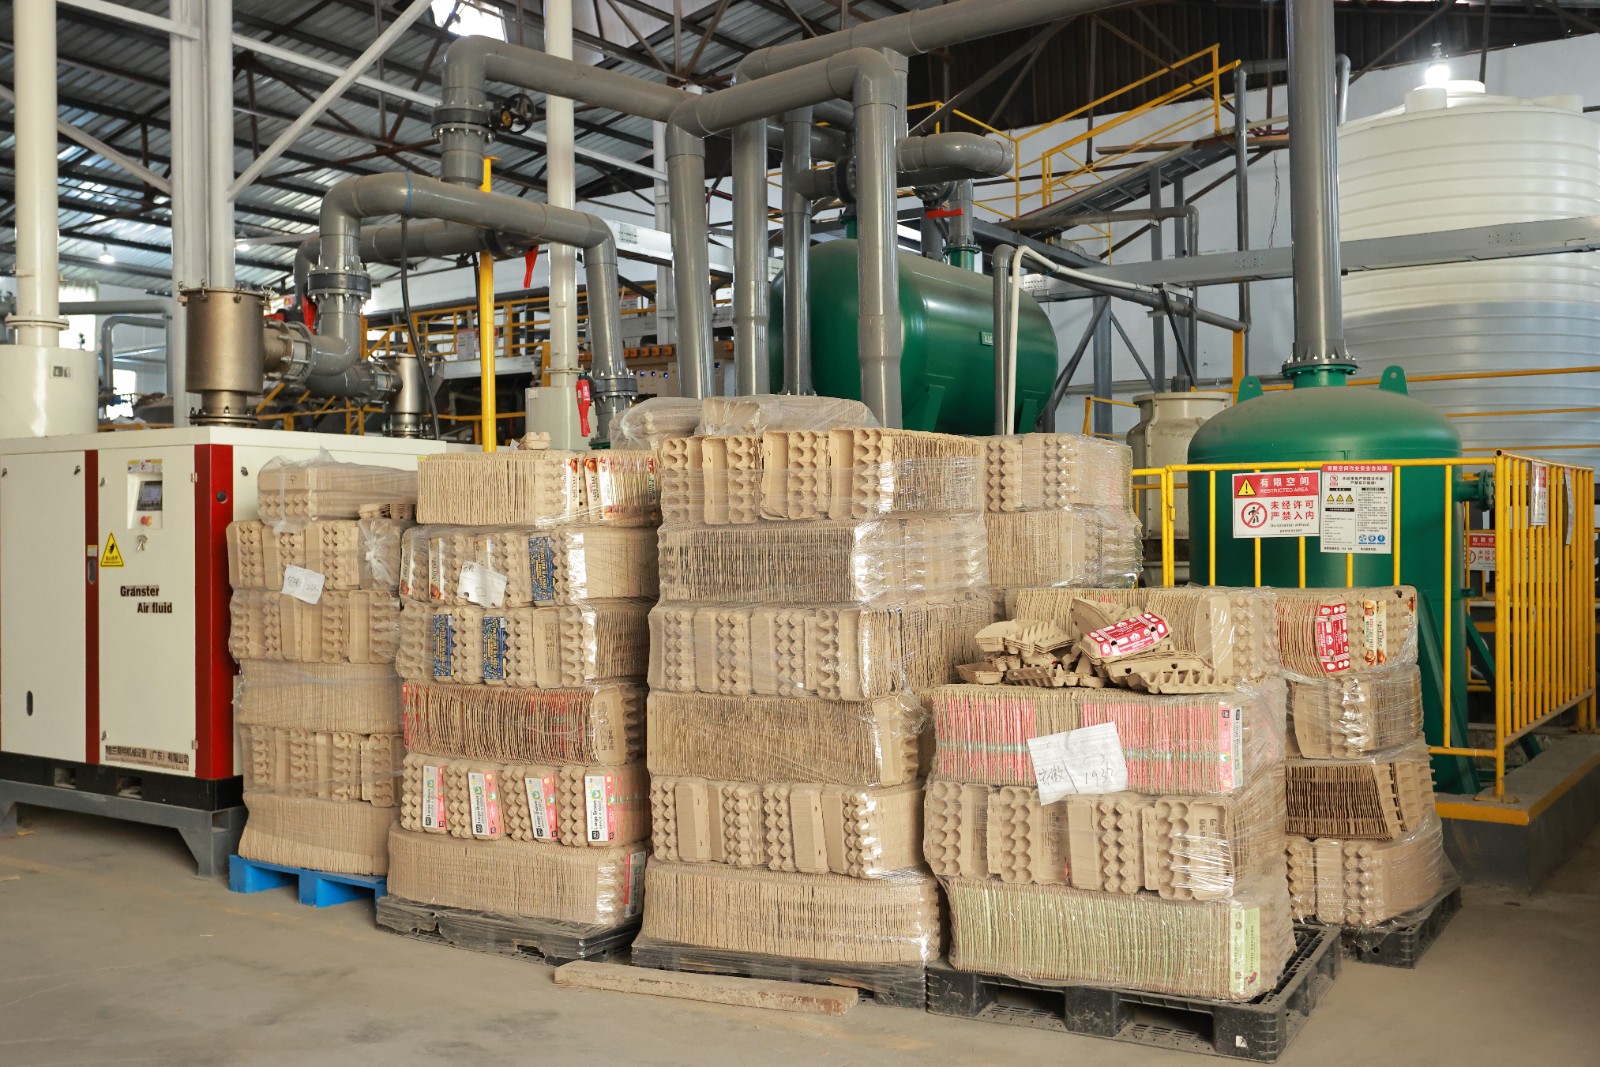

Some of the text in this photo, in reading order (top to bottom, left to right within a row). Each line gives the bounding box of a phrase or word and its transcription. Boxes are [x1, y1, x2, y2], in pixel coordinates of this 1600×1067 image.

[1260, 476, 1309, 487] 有限空间
[1270, 500, 1314, 510] 未经许可
[1270, 511, 1315, 521] 严禁入内
[137, 602, 172, 613] Air fluid
